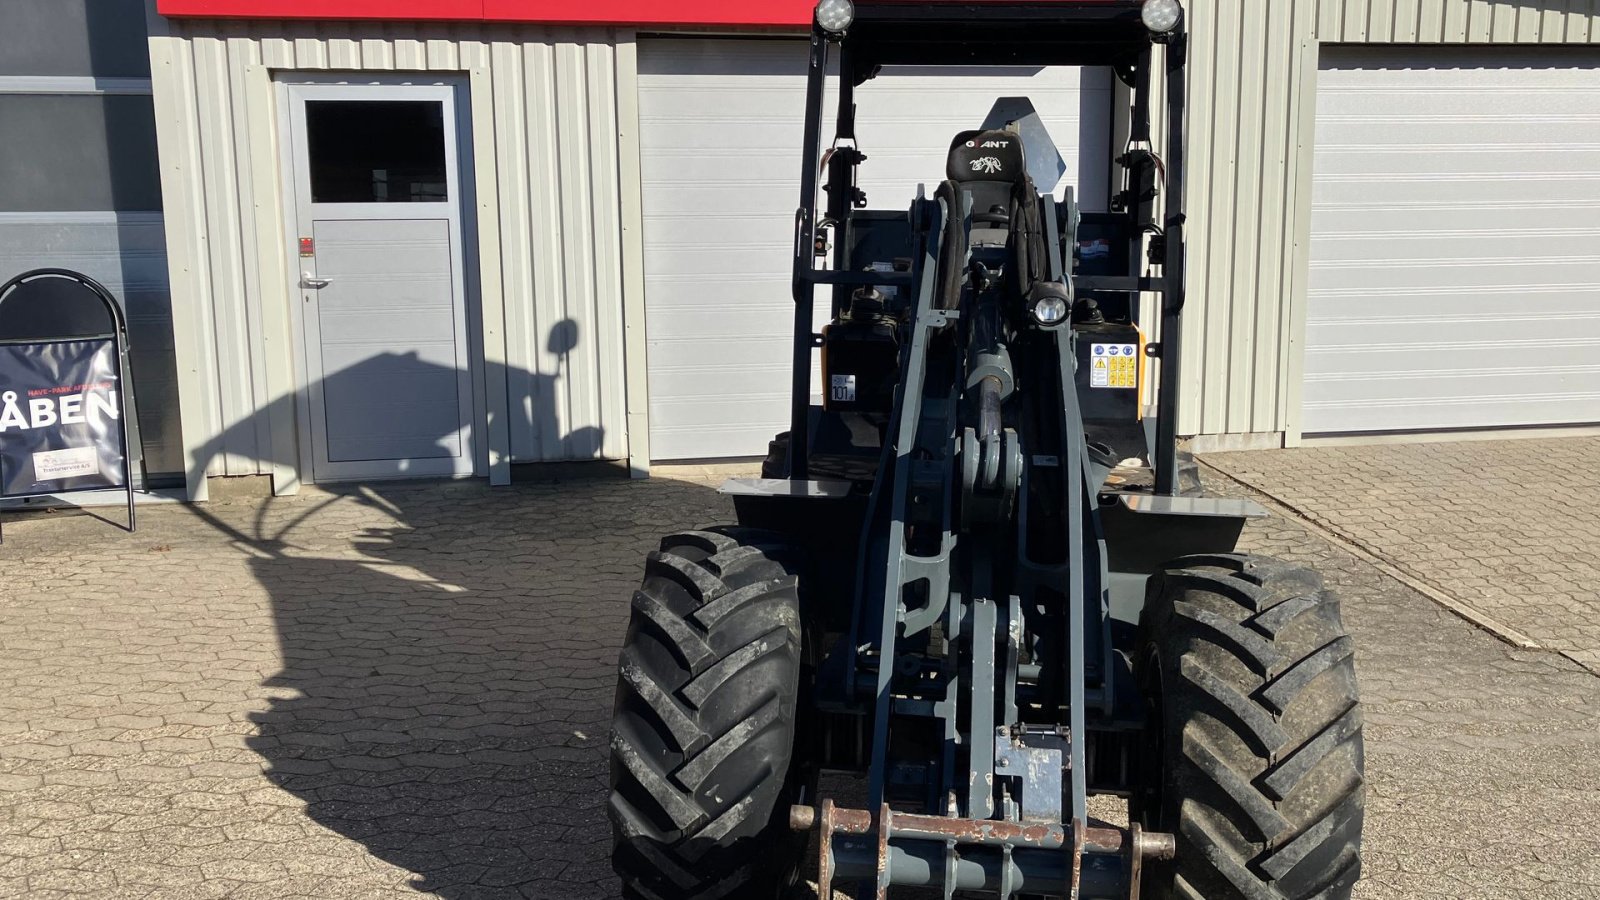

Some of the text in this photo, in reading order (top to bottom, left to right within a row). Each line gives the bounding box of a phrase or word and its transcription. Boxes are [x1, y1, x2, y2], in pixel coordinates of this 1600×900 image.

[966, 140, 1008, 148] GIANT
[28, 382, 112, 397] HAVE-PARK AFDNG
[833, 386, 848, 400] 101
[0, 391, 119, 434] ÅBEN
